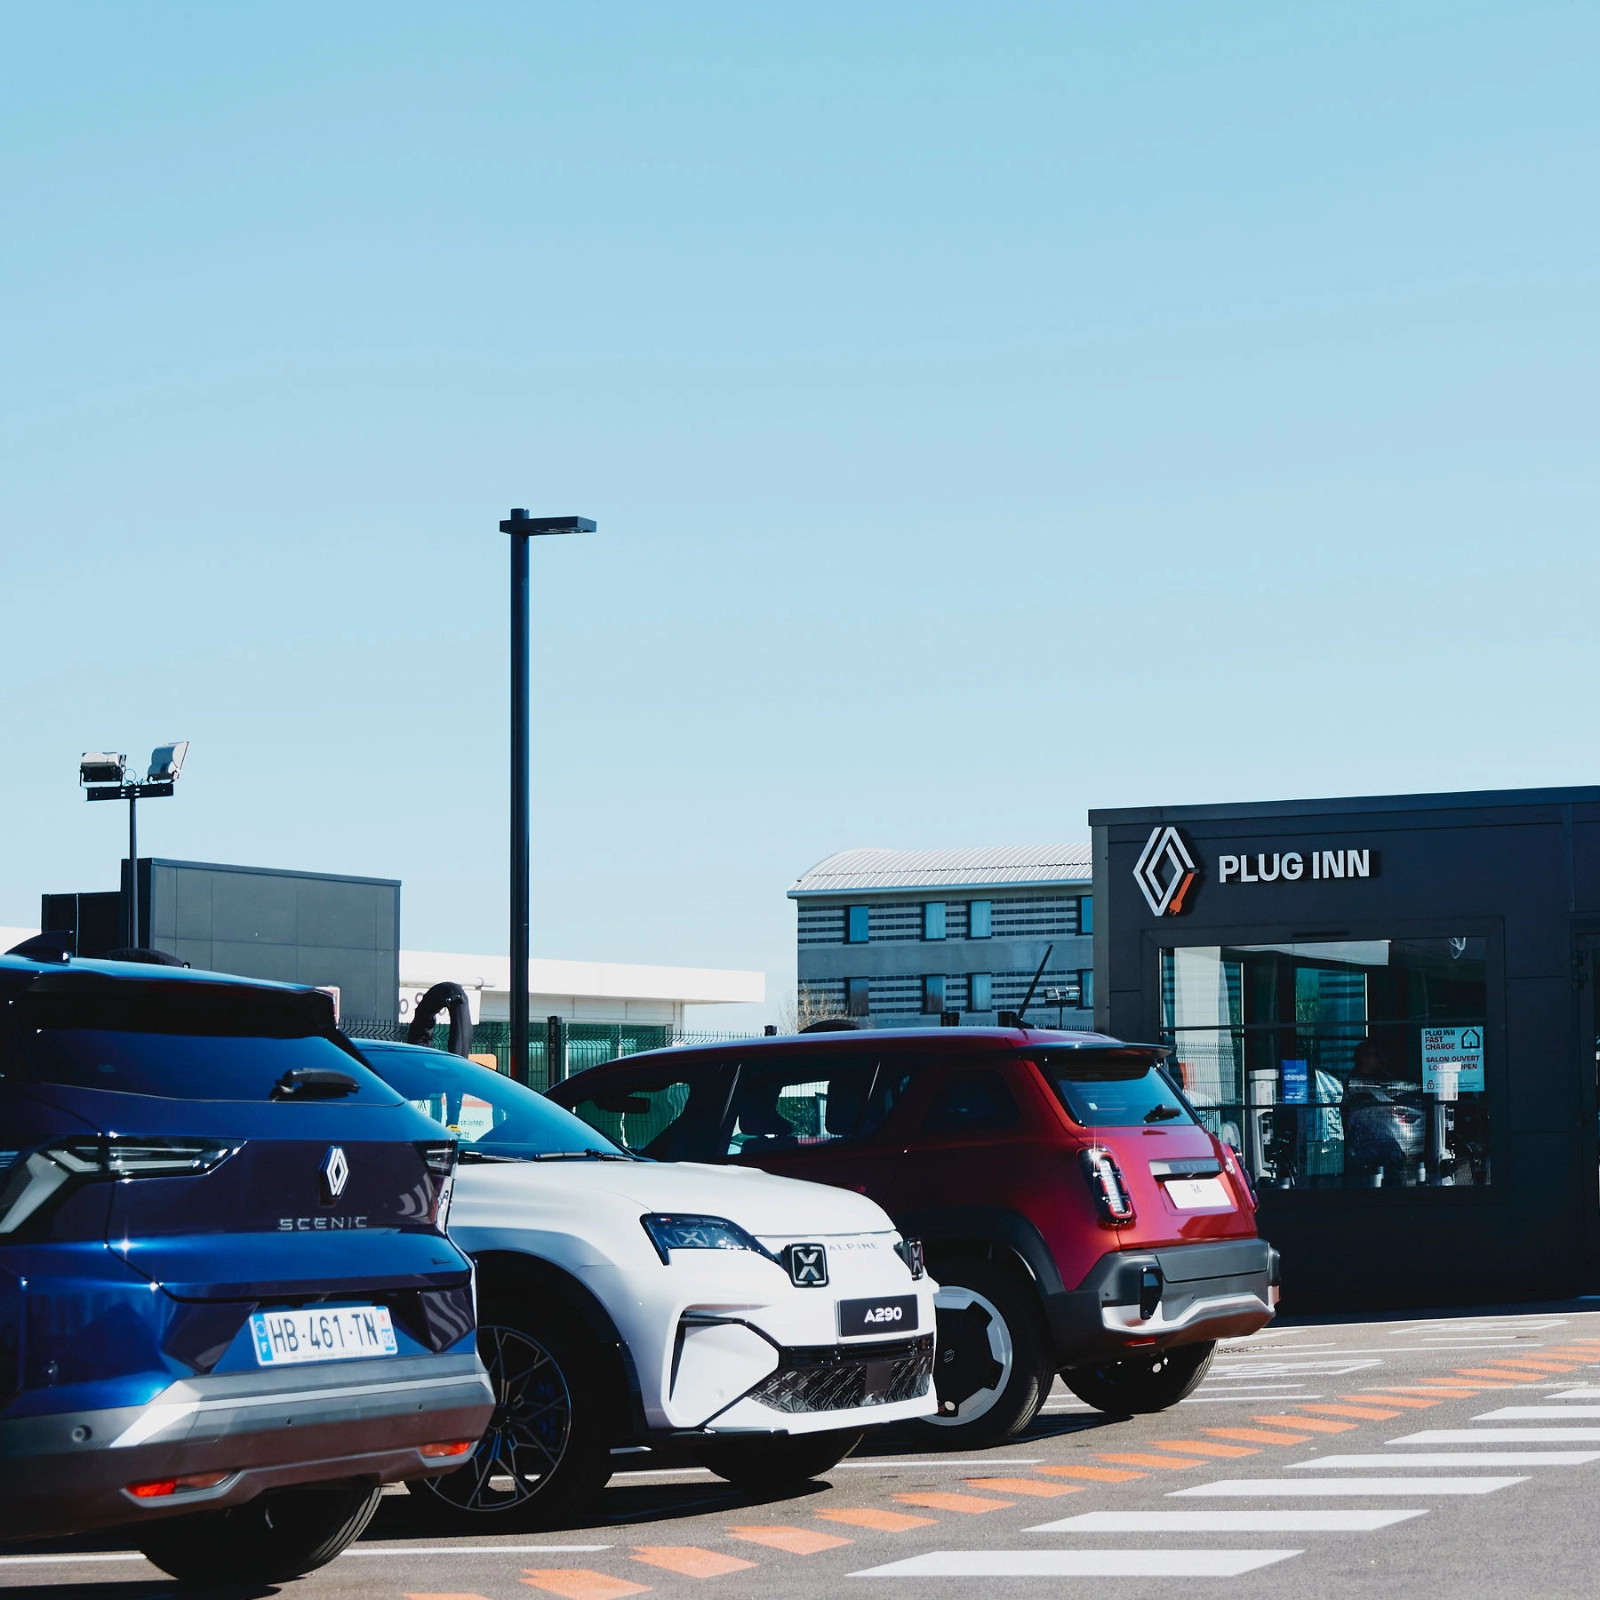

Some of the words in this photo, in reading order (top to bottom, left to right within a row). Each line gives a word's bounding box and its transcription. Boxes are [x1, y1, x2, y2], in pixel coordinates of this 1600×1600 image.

[1218, 852, 1304, 883] PLUG
[1312, 849, 1370, 880] INN
[278, 1216, 368, 1230] SCENIC
[829, 1242, 880, 1251] ALPINE
[864, 1307, 903, 1323] A290
